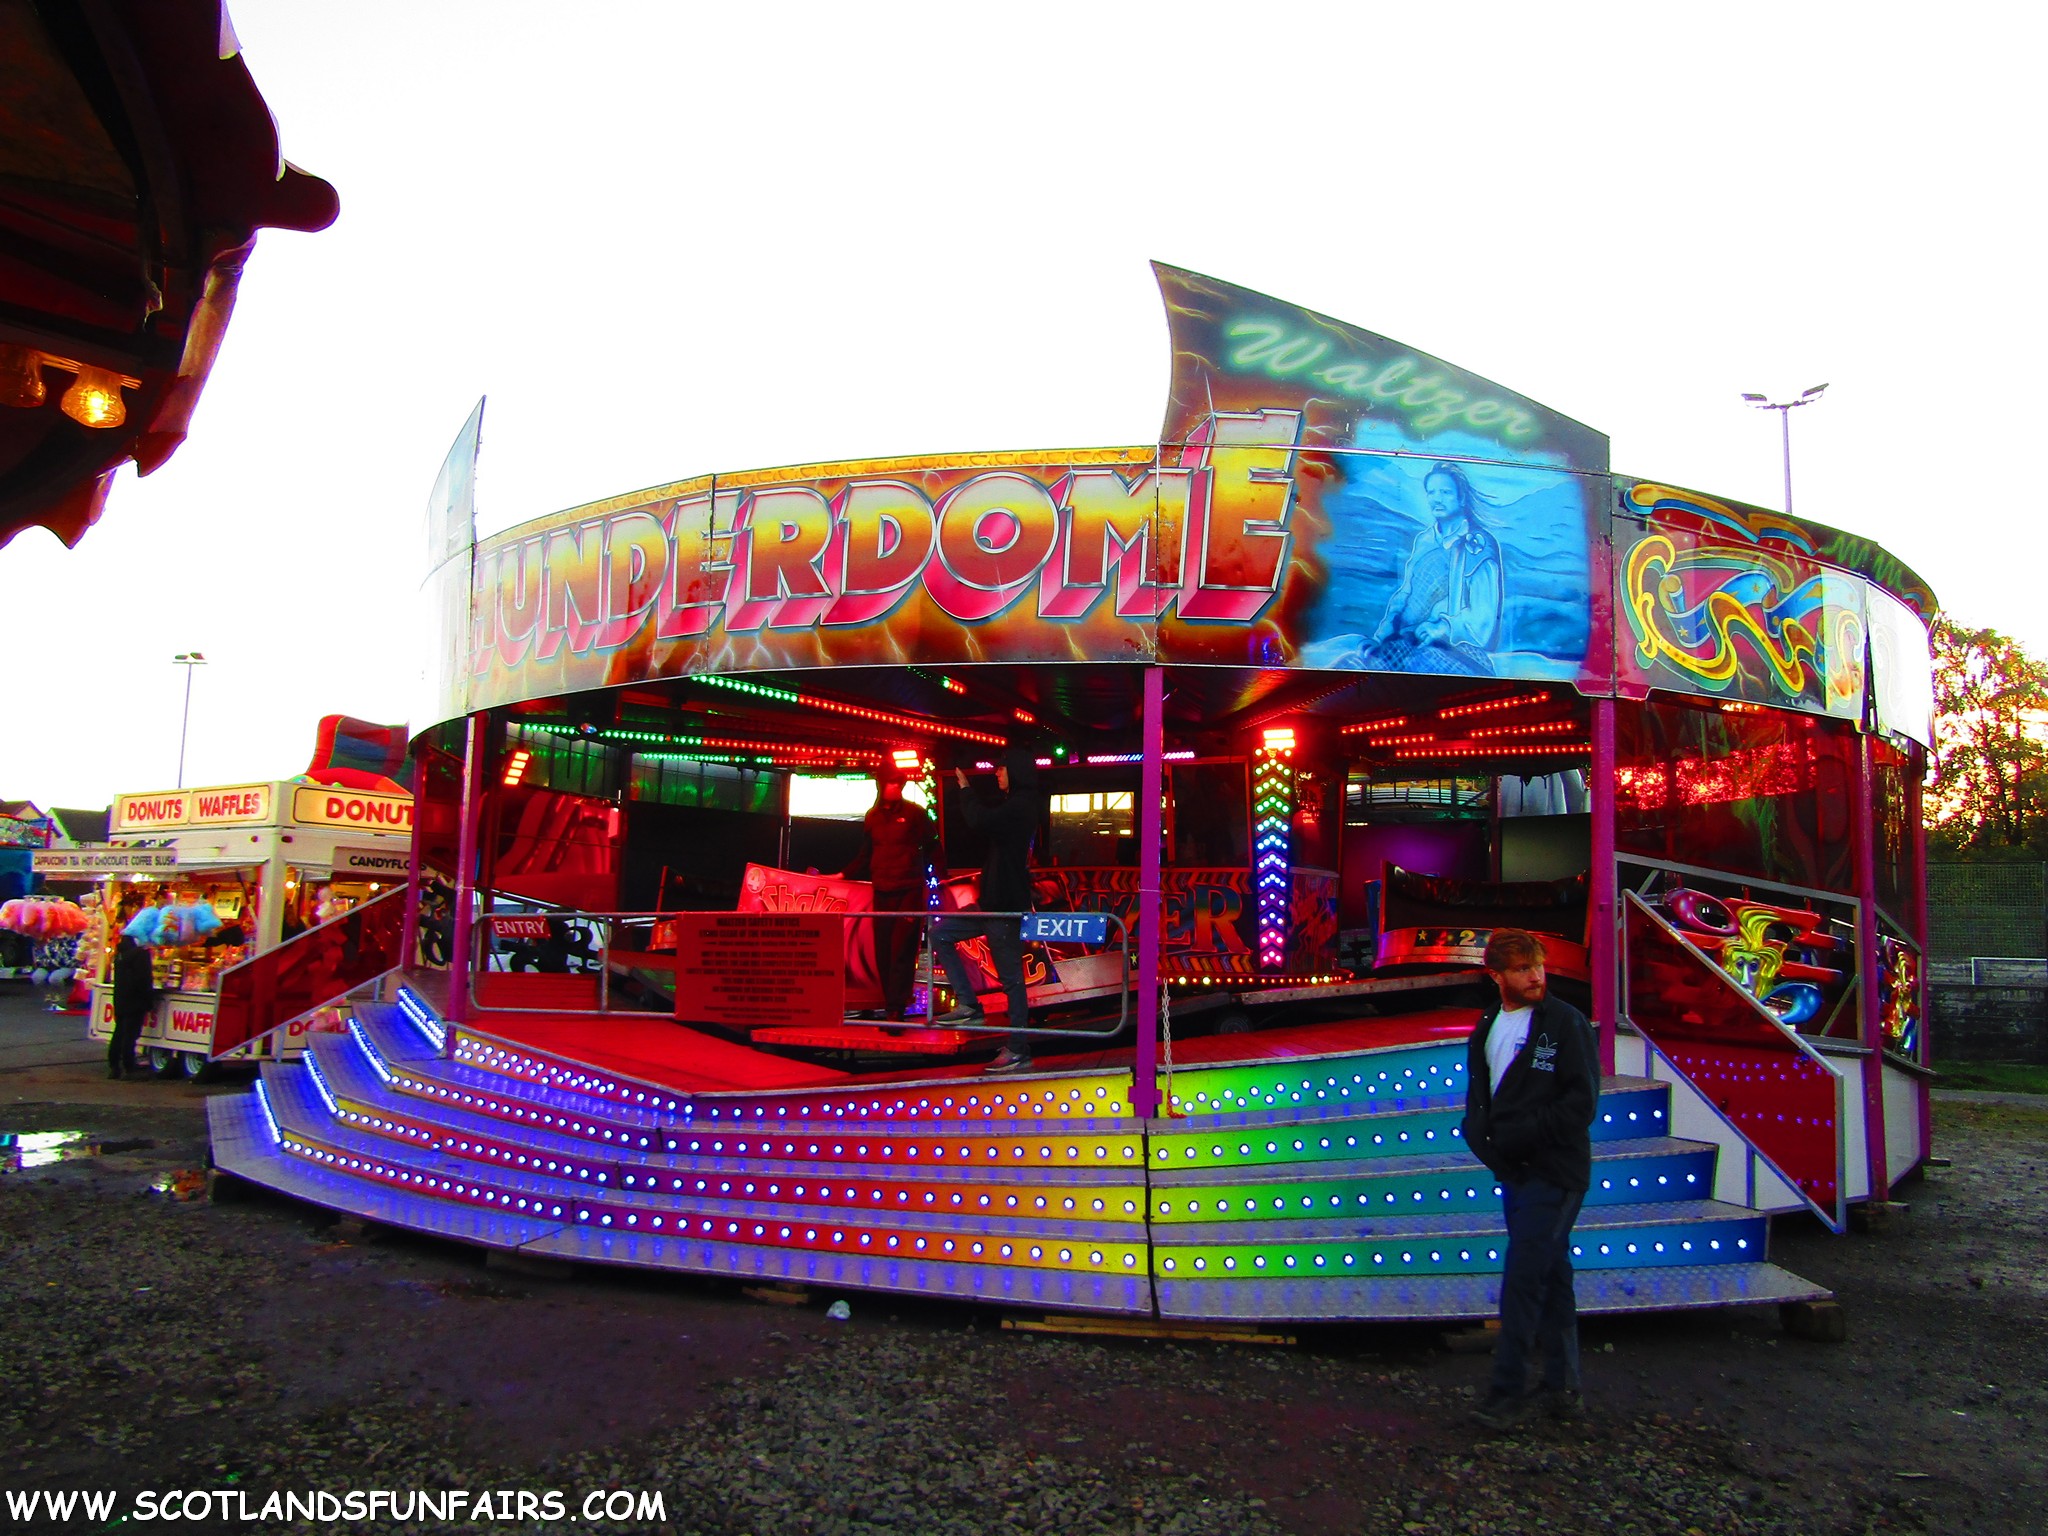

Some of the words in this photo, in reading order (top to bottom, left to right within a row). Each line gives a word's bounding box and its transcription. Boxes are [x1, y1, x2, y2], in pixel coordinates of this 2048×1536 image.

[1229, 323, 1534, 436] Waltzer
[128, 798, 183, 821] DONUTS
[199, 793, 261, 817] WAFFLES
[326, 797, 414, 825] DONUT
[34, 856, 68, 866] CAPPUCCINO
[82, 856, 94, 866] HOT
[95, 856, 128, 866] CHOCOLATE
[131, 856, 152, 866] COFFEE
[155, 856, 176, 866] SLUSH
[494, 921, 546, 934] ENTRY
[748, 917, 773, 927] SAFETY
[775, 917, 800, 927] NOTICE
[1036, 919, 1089, 938] EXIT
[1460, 929, 1476, 945] 2
[173, 1010, 214, 1035] WAFF
